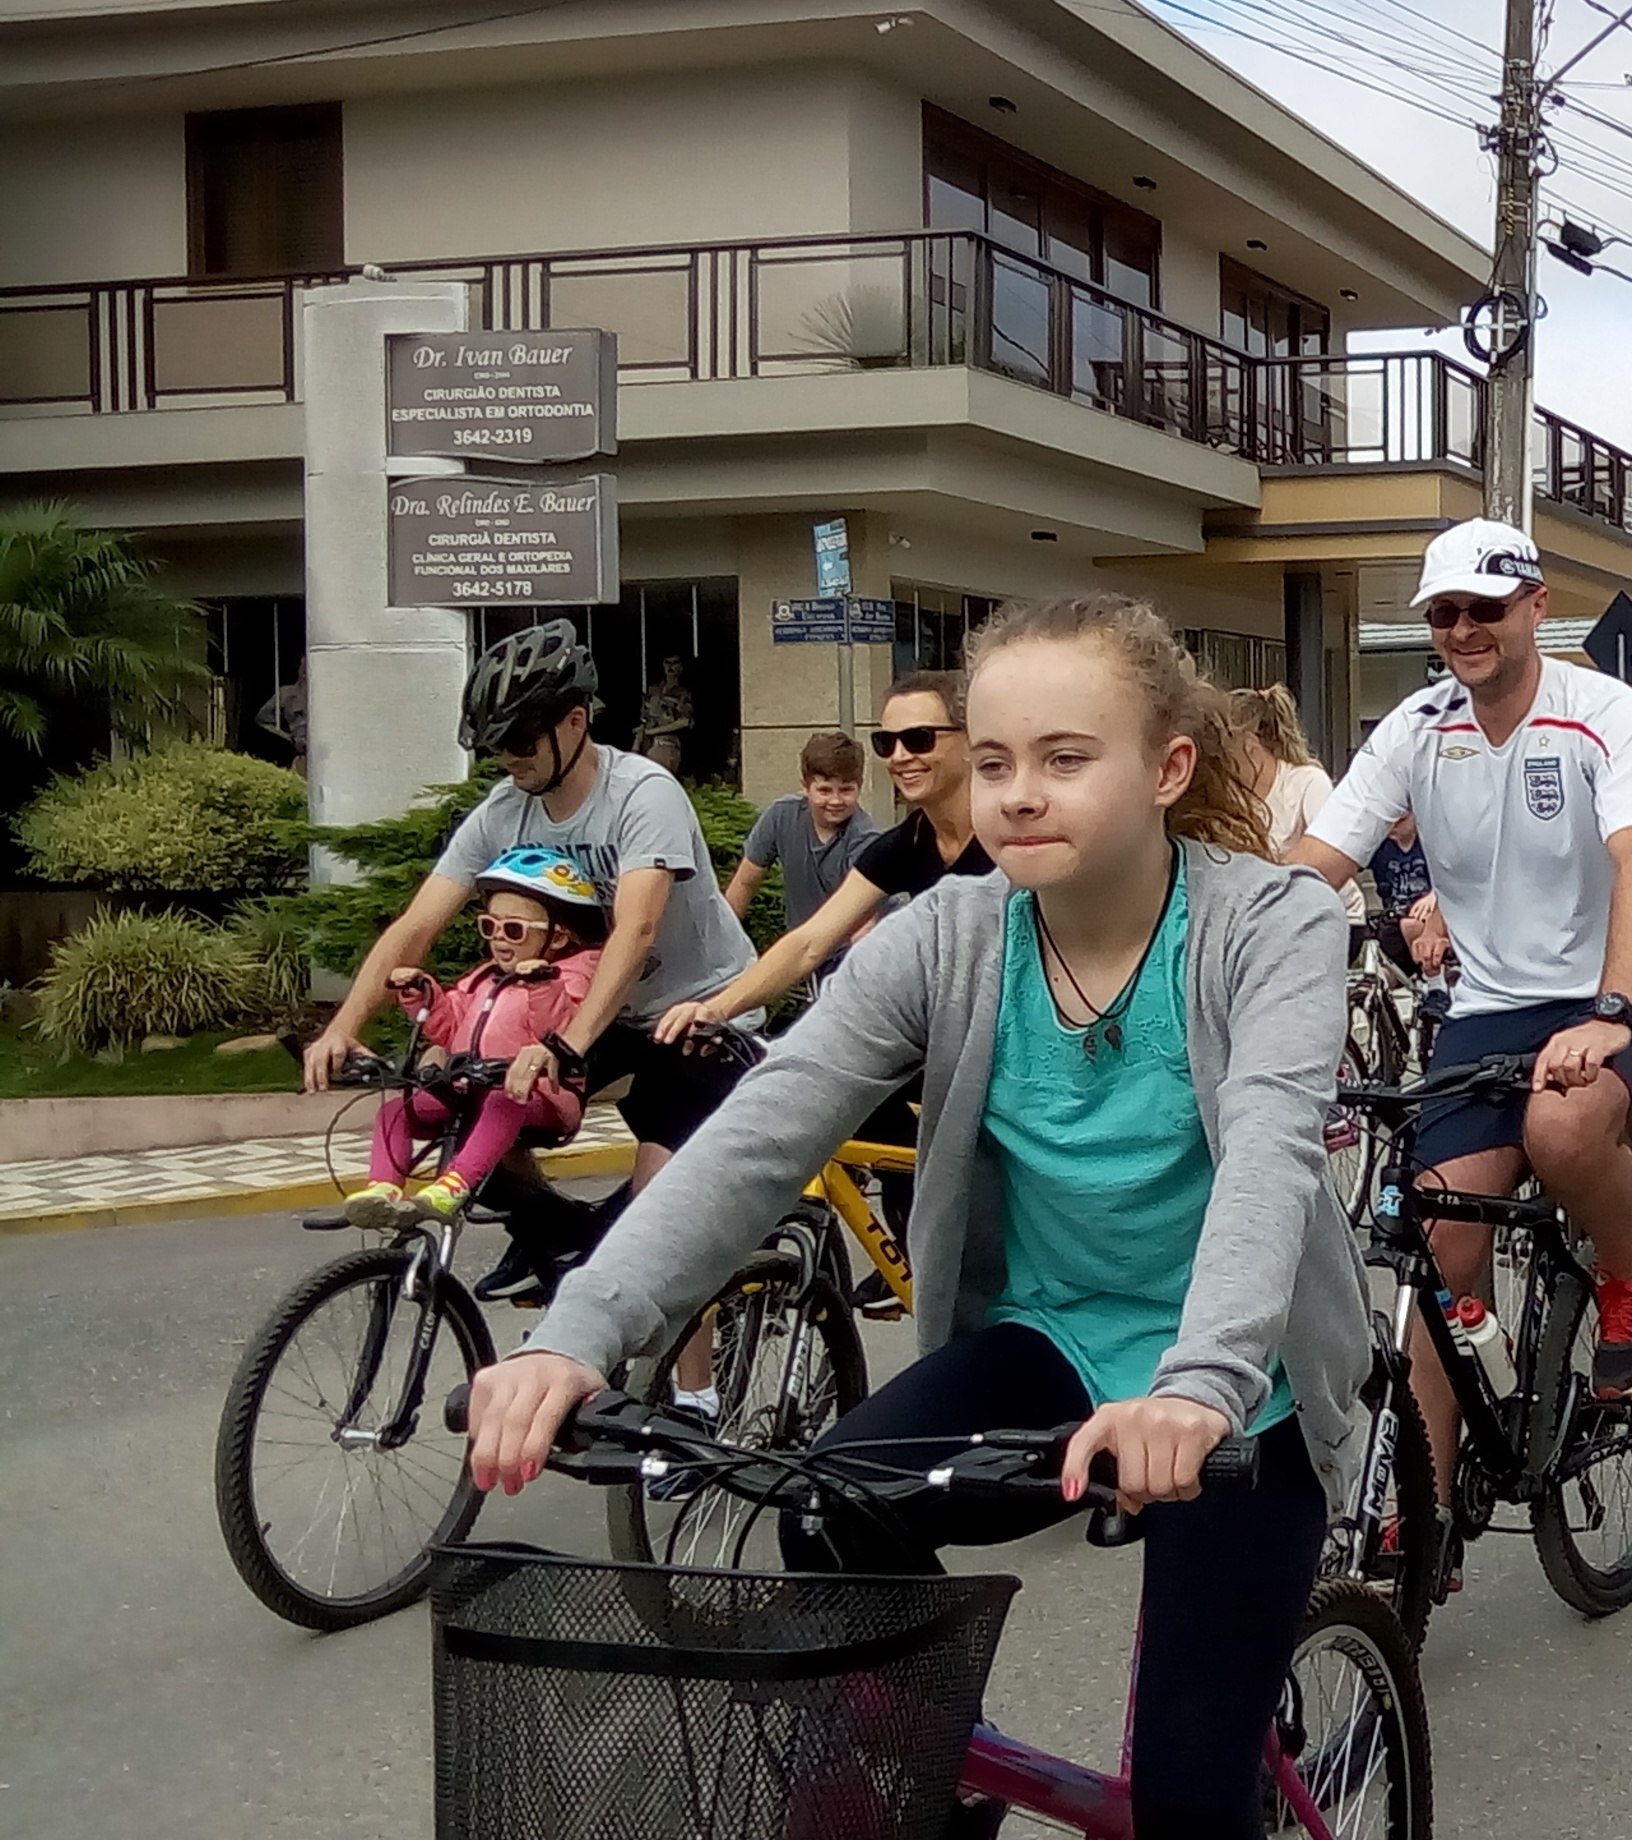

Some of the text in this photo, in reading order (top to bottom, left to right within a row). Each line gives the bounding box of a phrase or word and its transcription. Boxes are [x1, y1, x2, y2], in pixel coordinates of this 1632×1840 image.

[412, 344, 573, 369] Dr. Ivan Bauer
[424, 385, 561, 401] CIRURGIÃO DENTISTA
[391, 403, 595, 421] ESPECIALISTA EM ORTODONTIA
[453, 427, 533, 445] 3642-2319
[391, 491, 596, 518] Dra. Relindes E. Bauer
[494, 531, 557, 545] DENTISTA
[411, 550, 573, 564] CLÍNICA GERAL E ORTOPEDIA
[414, 562, 571, 576] FUNCIONAL DOS MAXILARES
[452, 580, 533, 597] 3642-5178
